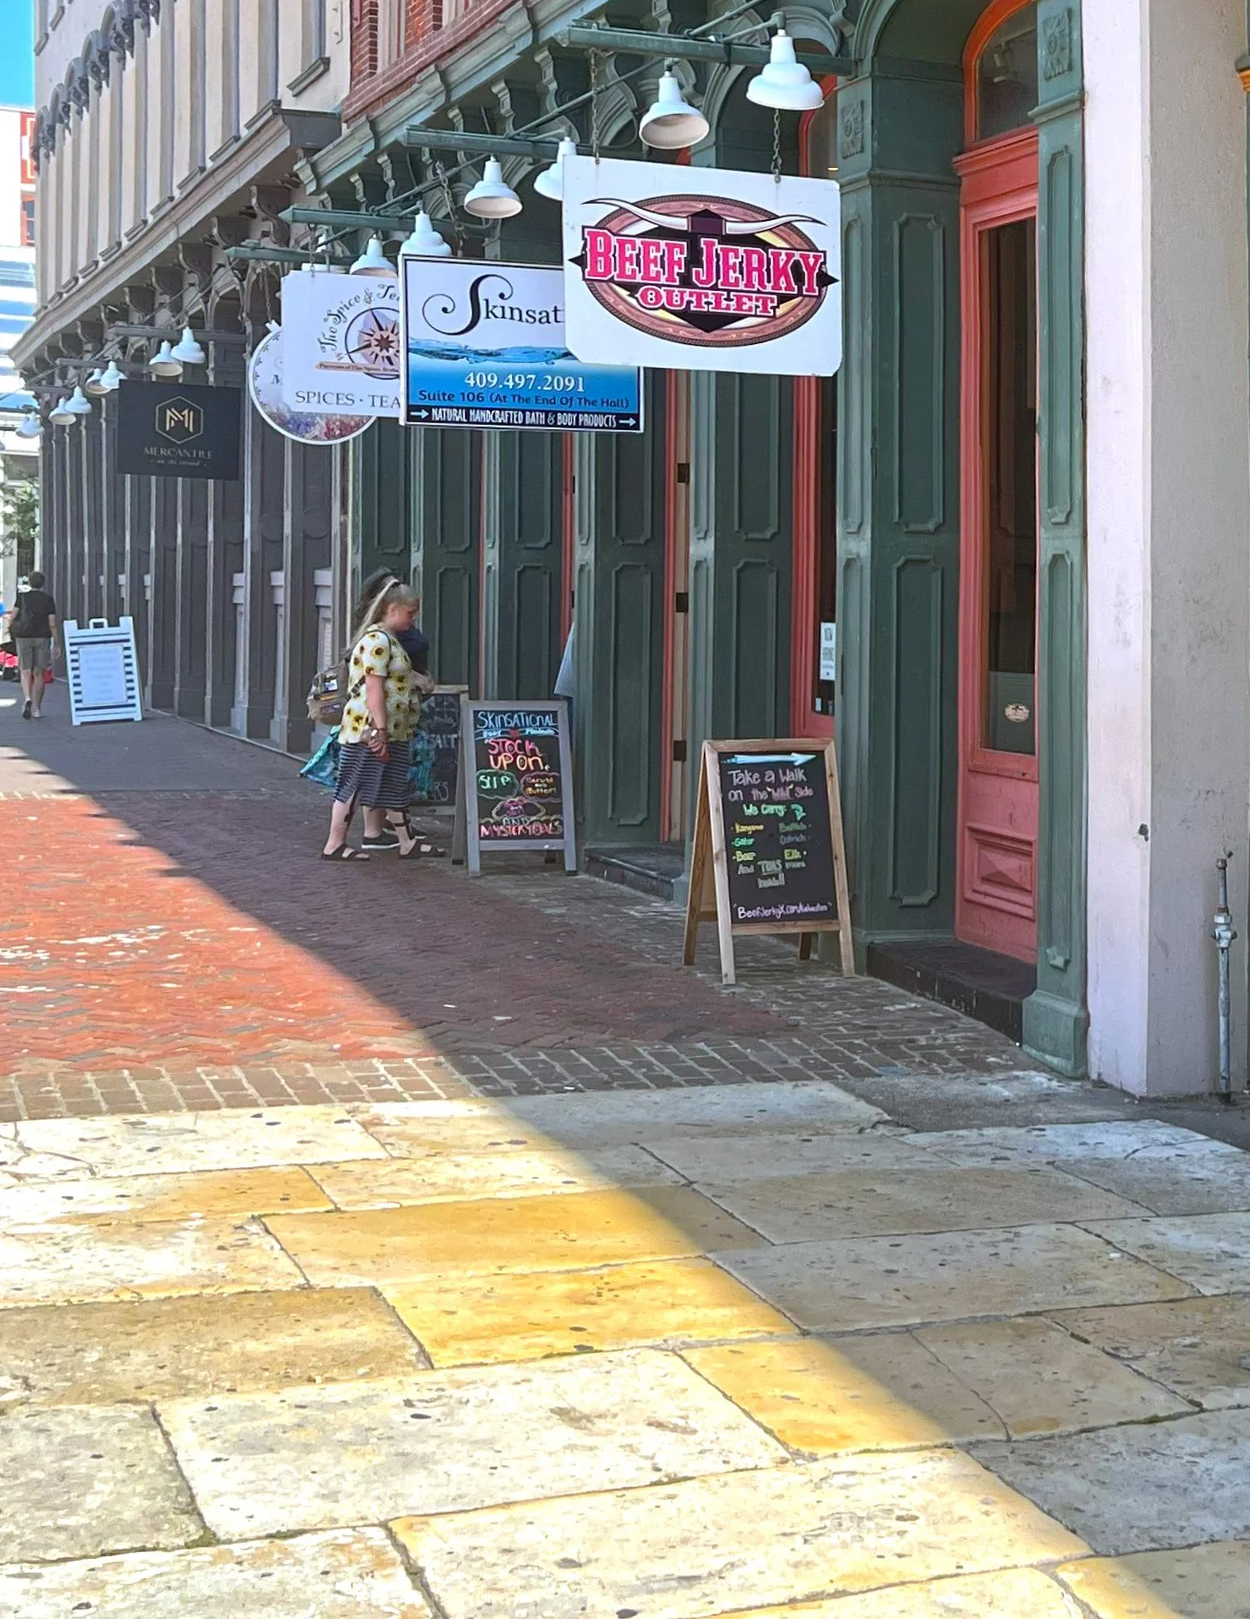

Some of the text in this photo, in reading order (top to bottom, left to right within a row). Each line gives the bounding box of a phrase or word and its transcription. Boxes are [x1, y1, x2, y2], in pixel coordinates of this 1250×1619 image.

[584, 228, 825, 296] BEEF JERKY
[323, 294, 361, 325] Spice
[421, 274, 565, 336] Skinsat
[638, 285, 778, 317] OUTLET
[464, 371, 585, 392] 409.497.2091
[295, 390, 355, 406] SPICES
[418, 389, 629, 409] Suite 106 (At The End Of The Hall)
[431, 407, 617, 428] NATURAL HANDCRAFTED BATH & BODY PRODUCTS
[143, 447, 212, 460] MERCANTILE
[488, 738, 543, 756] STOCK
[727, 767, 807, 786] Take a Walk
[728, 789, 744, 802] on
[751, 788, 769, 801] the
[794, 786, 814, 798] Side
[742, 803, 759, 816] We
[737, 863, 755, 875] And
